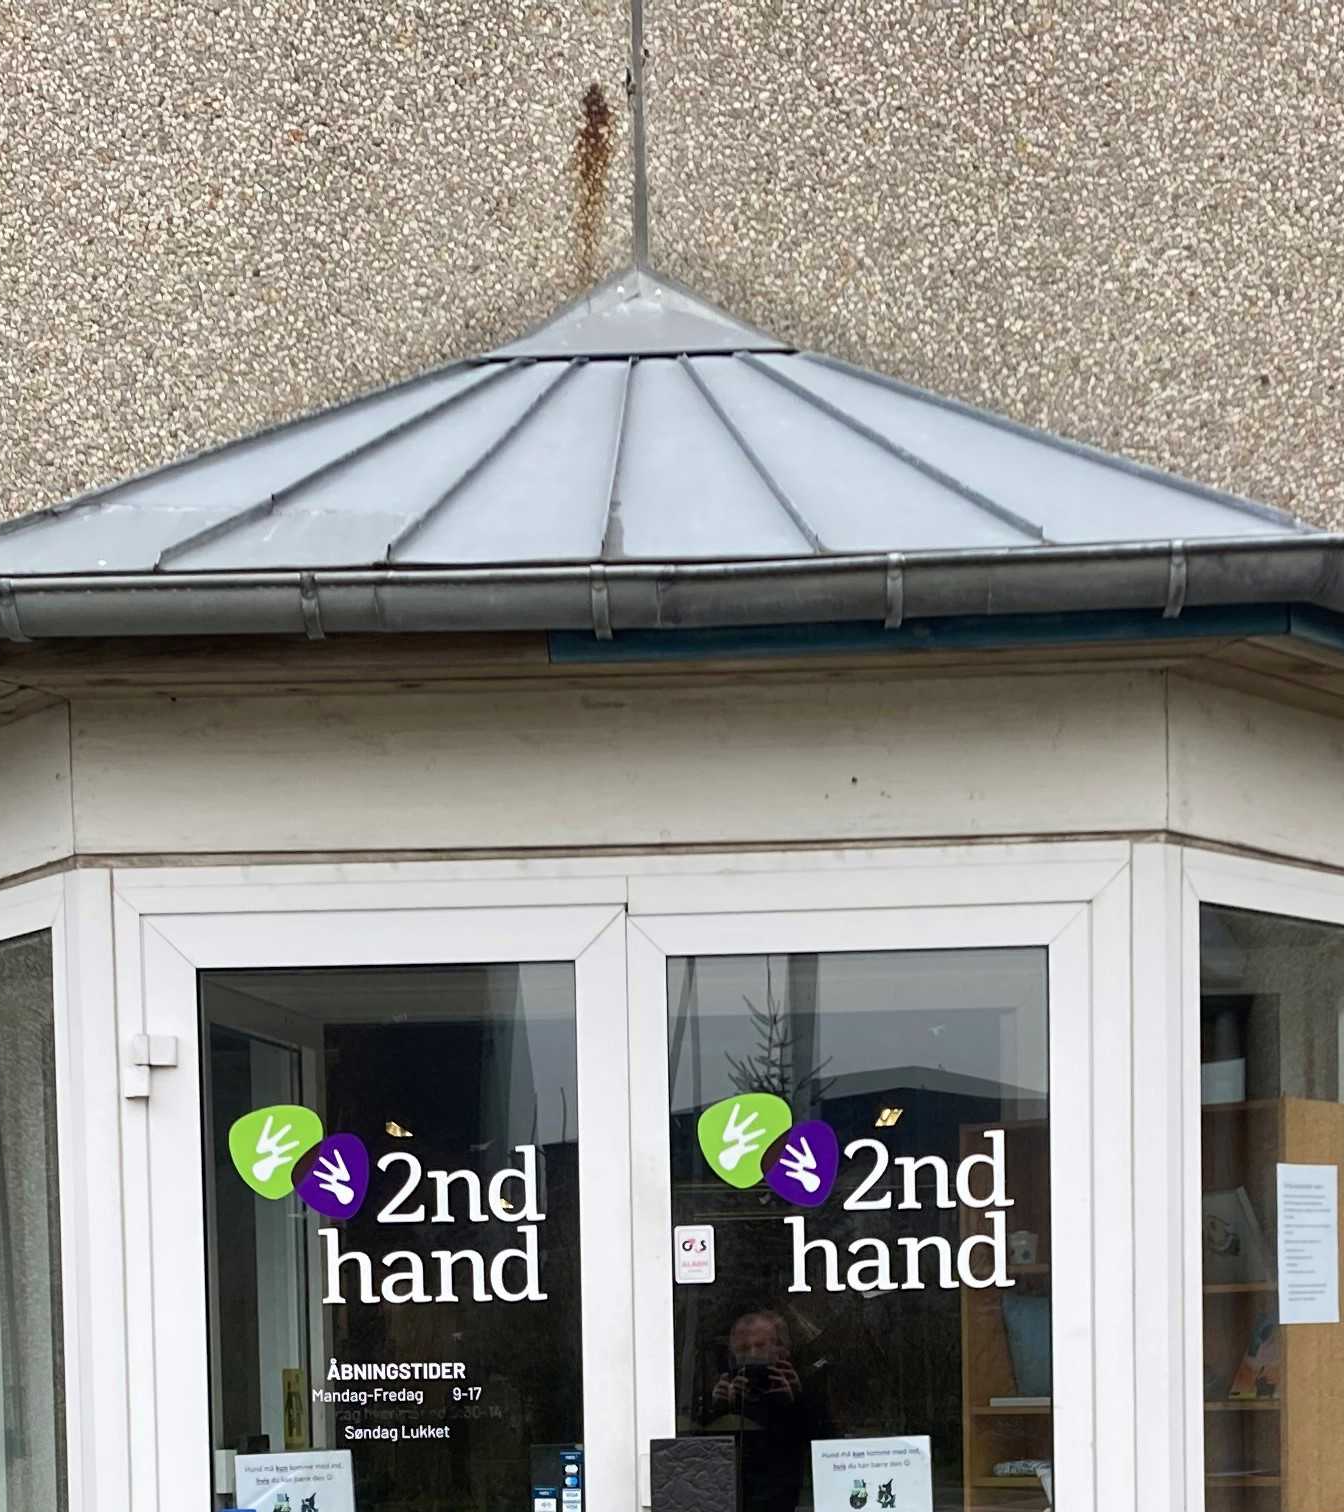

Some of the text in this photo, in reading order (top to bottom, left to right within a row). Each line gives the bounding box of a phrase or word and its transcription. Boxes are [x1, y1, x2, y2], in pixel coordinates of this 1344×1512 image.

[375, 1144, 546, 1224] 2nd
[842, 1129, 1016, 1211] 2nd
[318, 1224, 548, 1306] hand
[783, 1210, 1016, 1294] hand
[312, 1386, 482, 1406] Mandag-Fredag 9-17
[327, 1357, 466, 1381] ÅBNINGSTIDER
[344, 1425, 451, 1442] Søndag Lukket
